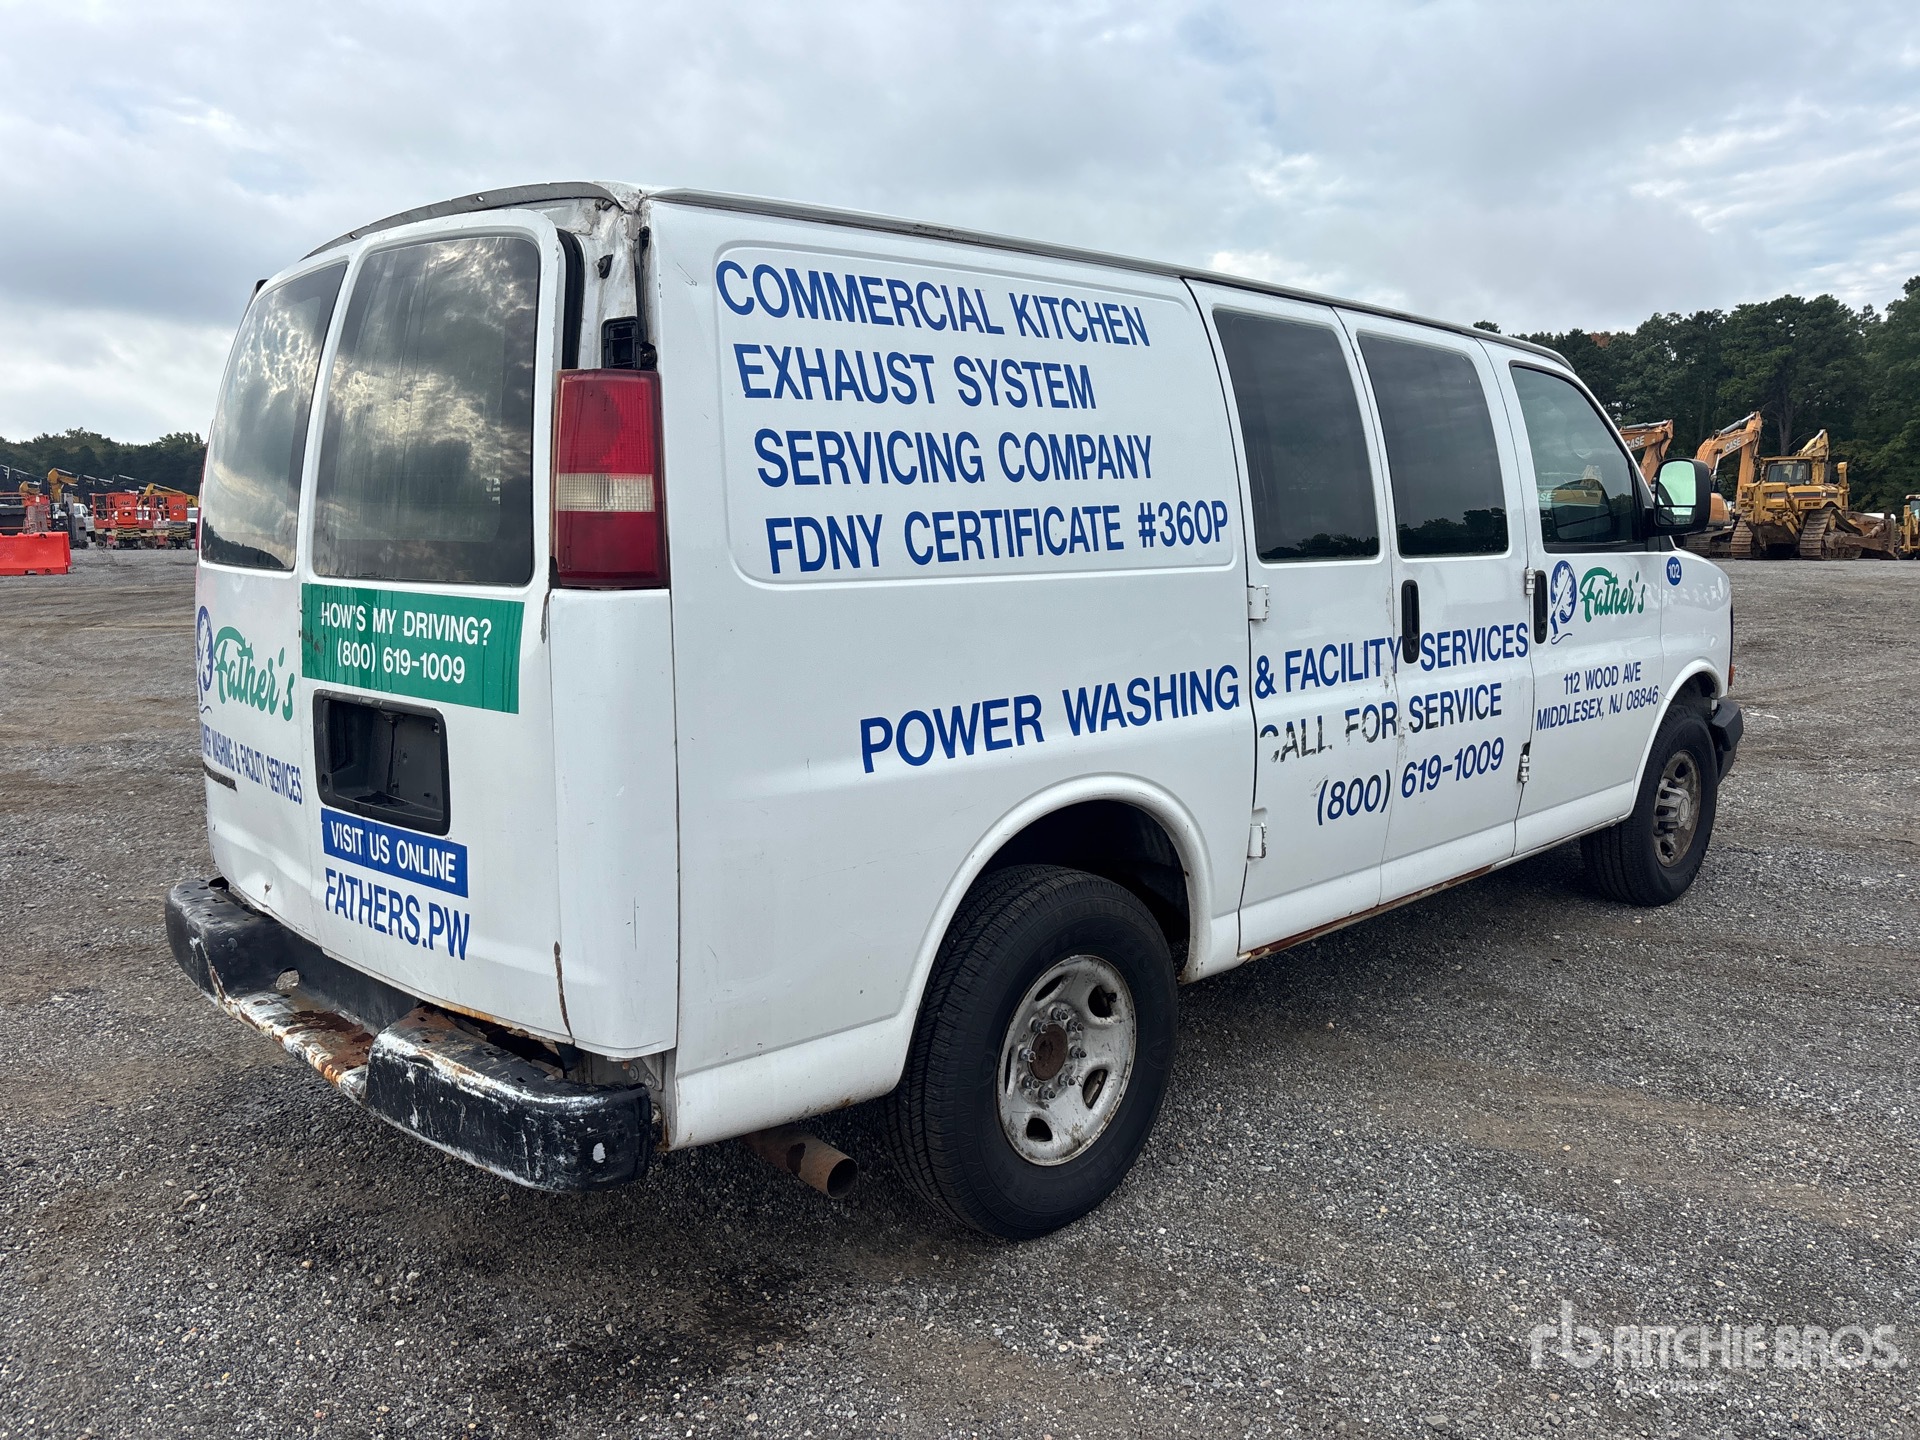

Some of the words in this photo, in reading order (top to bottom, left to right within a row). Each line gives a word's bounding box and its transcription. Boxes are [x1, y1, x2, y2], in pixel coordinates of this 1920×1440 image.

[716, 260, 1005, 335] COMMERCIAL
[1009, 292, 1150, 347] KITCHEN
[733, 343, 936, 404] EXHAUST
[953, 355, 1097, 410] SYSTEM
[754, 428, 985, 488] SERVICING
[998, 431, 1152, 484] COMPANY
[1725, 436, 1741, 452] CASE
[765, 513, 883, 574] FDNY
[904, 504, 1125, 566] CERTIFICATE
[1137, 500, 1229, 549] #360P
[1580, 566, 1646, 623] Father's
[1668, 564, 1680, 579] 102
[321, 601, 366, 632] HOW'S
[372, 607, 397, 635] MY
[403, 610, 492, 646] DRIVING?
[214, 626, 295, 721] Father's
[337, 637, 376, 673] (800)
[382, 646, 466, 684] 619-1009
[1563, 671, 1580, 695] 112
[1585, 665, 1619, 691] WOOD
[1623, 661, 1641, 684] AVE
[860, 694, 1045, 774] POWER
[1061, 663, 1240, 737] WASHING
[1255, 655, 1277, 700] &
[1284, 636, 1403, 692] FACILITY
[1419, 622, 1529, 672] SERVICES
[1345, 701, 1398, 743] FOR
[1409, 682, 1502, 733] SERVICE
[1536, 696, 1605, 732] MIDDLESEX,
[1608, 692, 1623, 715] NJ
[1626, 684, 1659, 711] 08846
[266, 754, 303, 805] SERVICES
[1317, 769, 1391, 825] (800)
[1401, 736, 1504, 799] 619-1009
[330, 820, 364, 856] VISIT
[369, 831, 391, 864] US
[396, 839, 457, 884] ONLINE
[325, 866, 471, 961] FATHERS.PW
